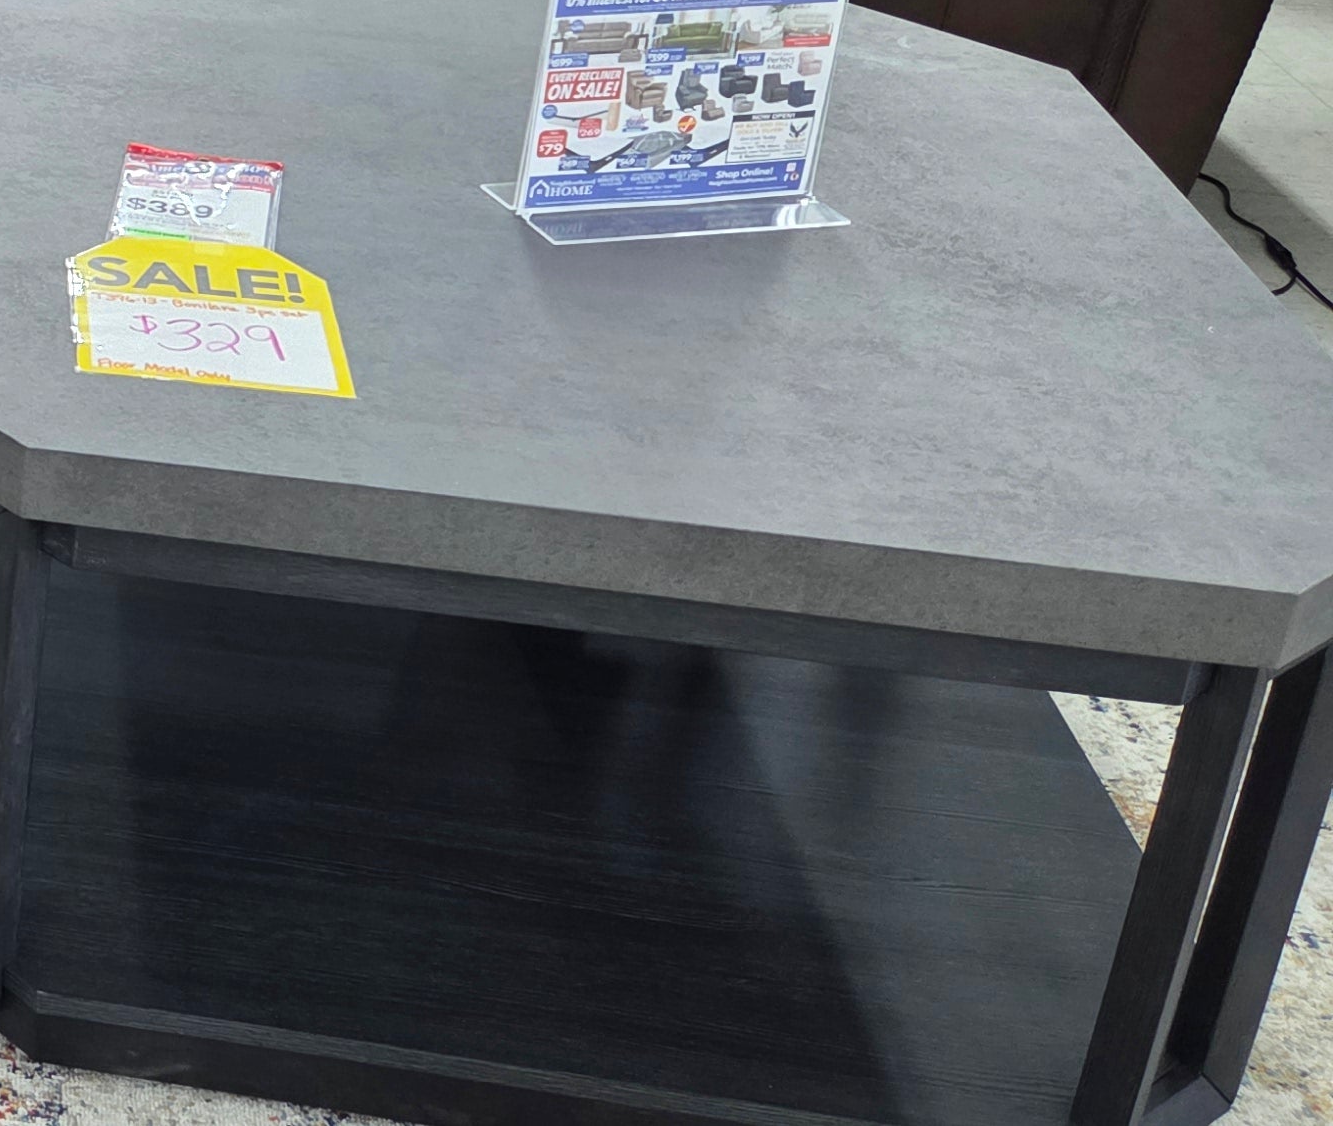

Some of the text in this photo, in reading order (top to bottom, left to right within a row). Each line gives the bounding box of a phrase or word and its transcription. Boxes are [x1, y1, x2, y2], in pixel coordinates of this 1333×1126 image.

[549, 70, 622, 83] EVERY RECLINER
[547, 80, 621, 101] ON SALE!
[539, 143, 564, 155] $79
[715, 170, 740, 179] Shop
[550, 185, 593, 197] HOME
[88, 256, 306, 304] SALE!
[129, 315, 286, 362] $329
[98, 357, 231, 382] Floor Model Only
